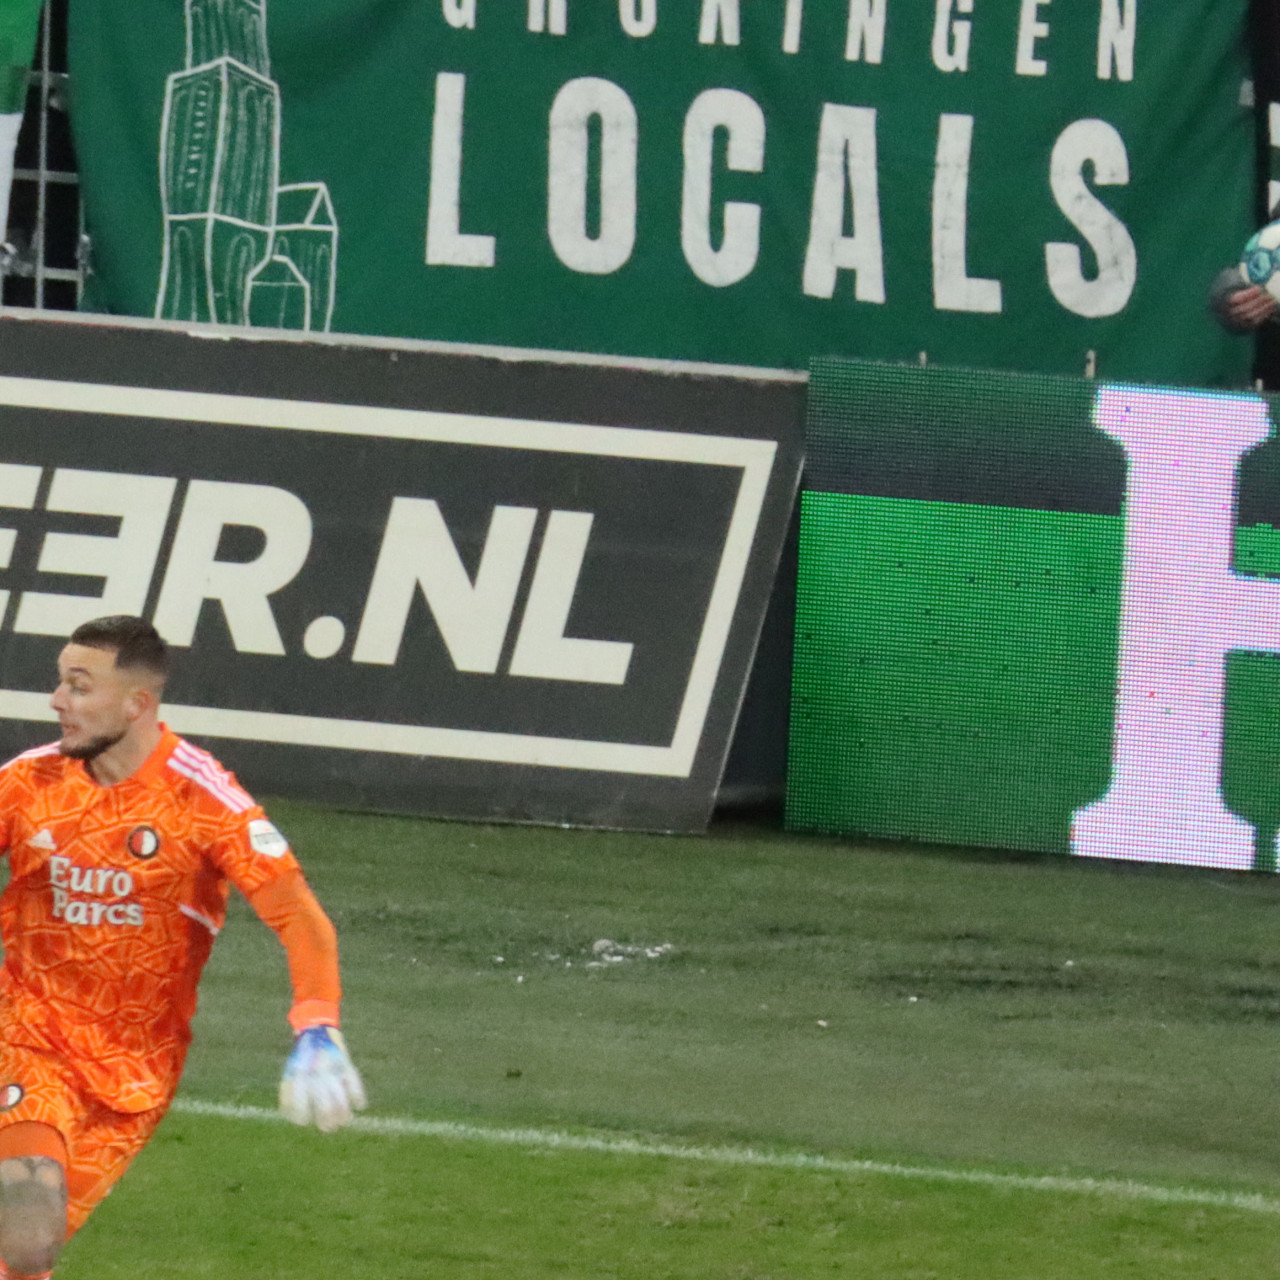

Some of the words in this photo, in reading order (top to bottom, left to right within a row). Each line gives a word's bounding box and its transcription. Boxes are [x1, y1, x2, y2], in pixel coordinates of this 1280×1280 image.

[440, 0, 1136, 81] INGEN
[425, 57, 1137, 319] LOCALS
[50, 855, 133, 897] Euro
[51, 887, 144, 926] Parcs
